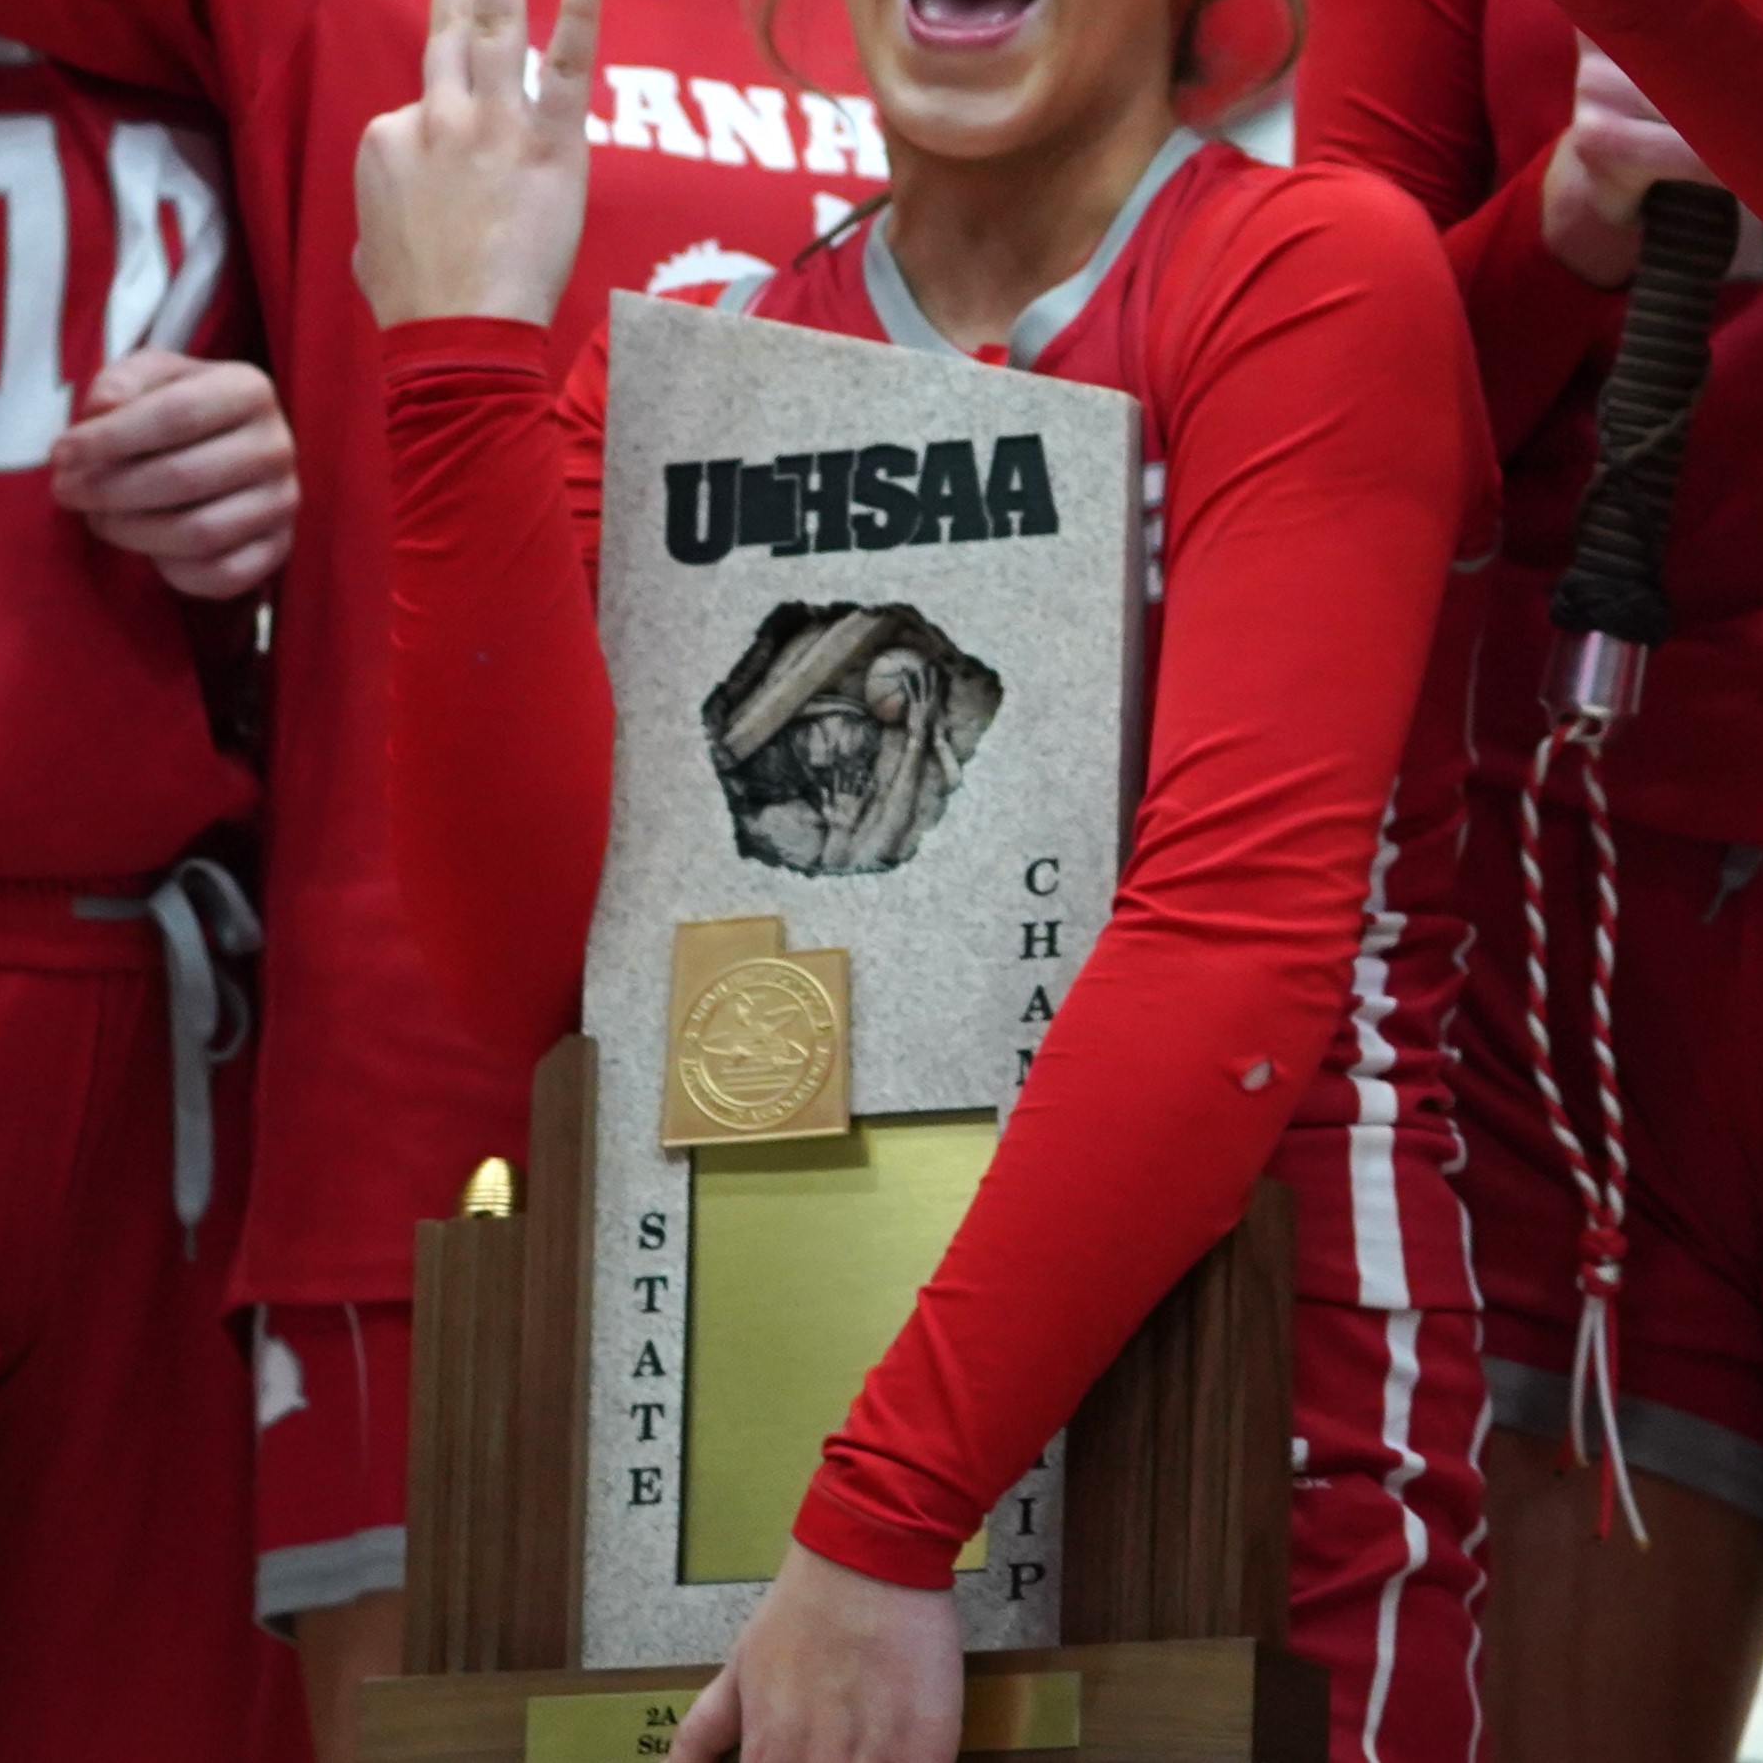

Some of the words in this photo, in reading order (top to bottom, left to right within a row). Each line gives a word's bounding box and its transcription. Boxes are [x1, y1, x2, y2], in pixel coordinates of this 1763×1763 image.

[665, 433, 1059, 565] UHSAA
[628, 1212, 669, 1506] STATE
[647, 1705, 678, 1726] 2A
